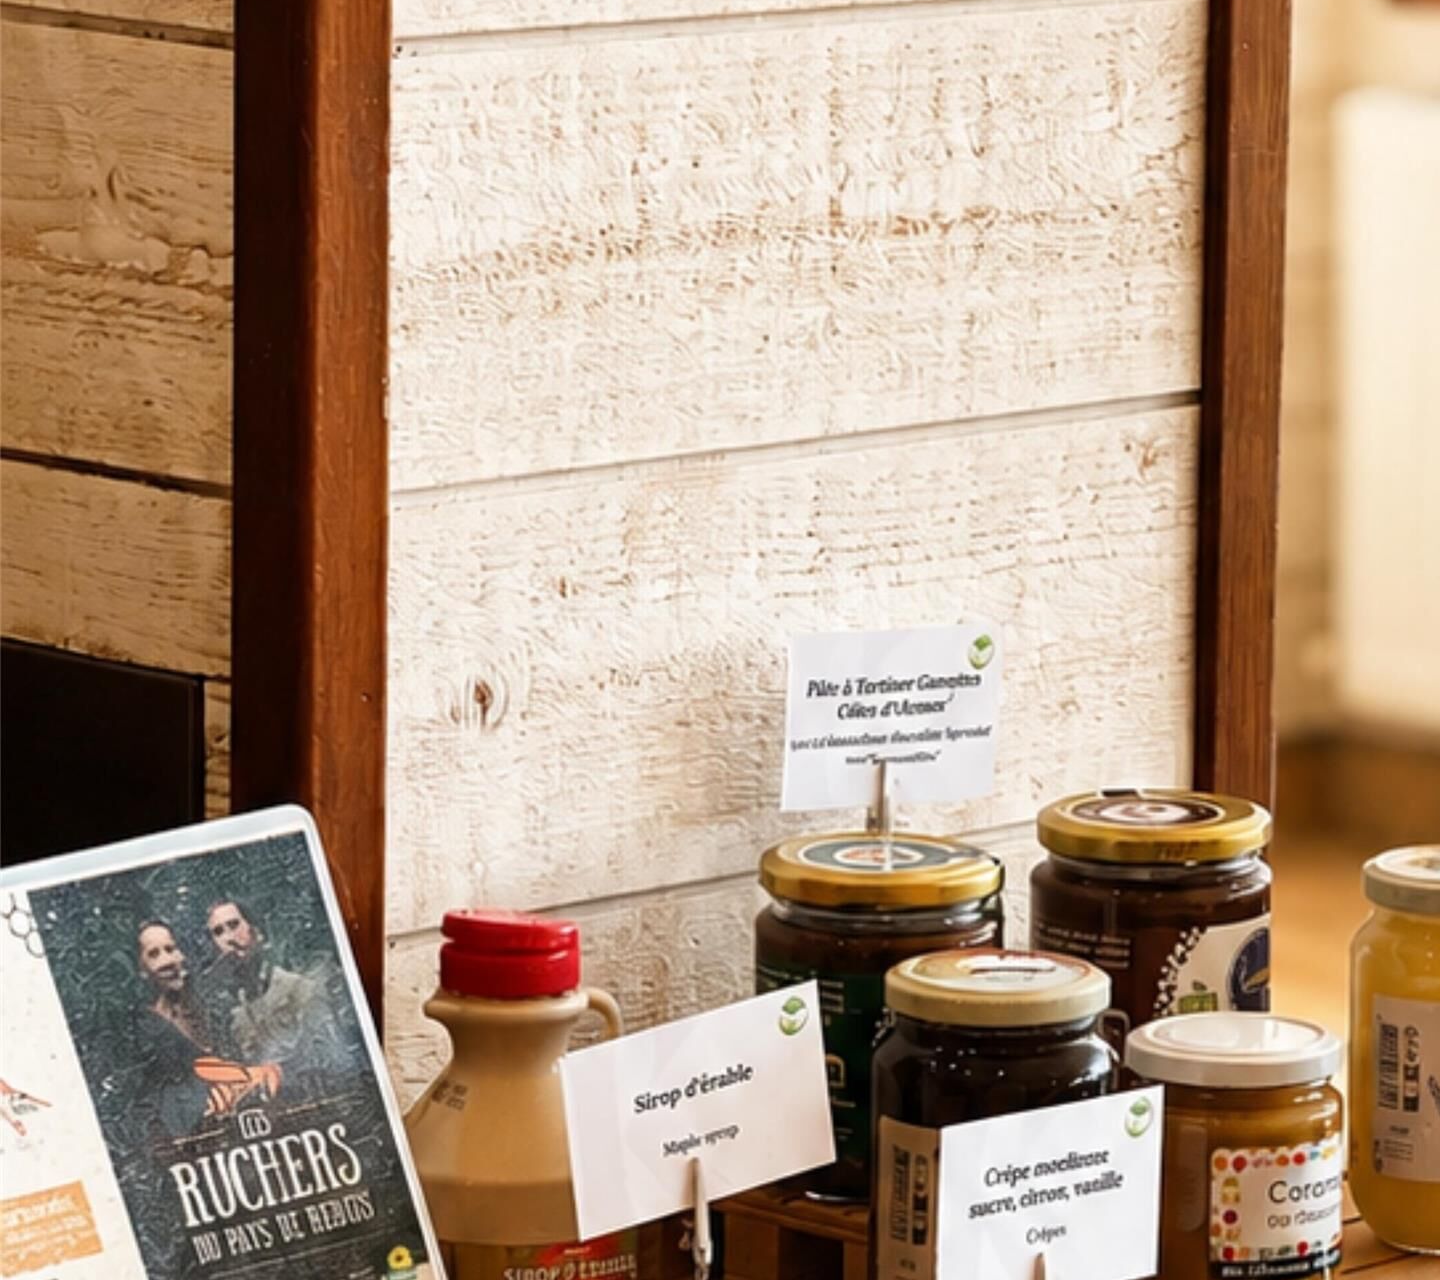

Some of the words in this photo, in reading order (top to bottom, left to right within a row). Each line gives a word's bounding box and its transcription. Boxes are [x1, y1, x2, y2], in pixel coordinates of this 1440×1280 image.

[633, 1087, 682, 1113] Sirop
[684, 1063, 753, 1099] d'érable
[169, 1122, 363, 1227] RUCHERS
[223, 1218, 274, 1257] PAYS
